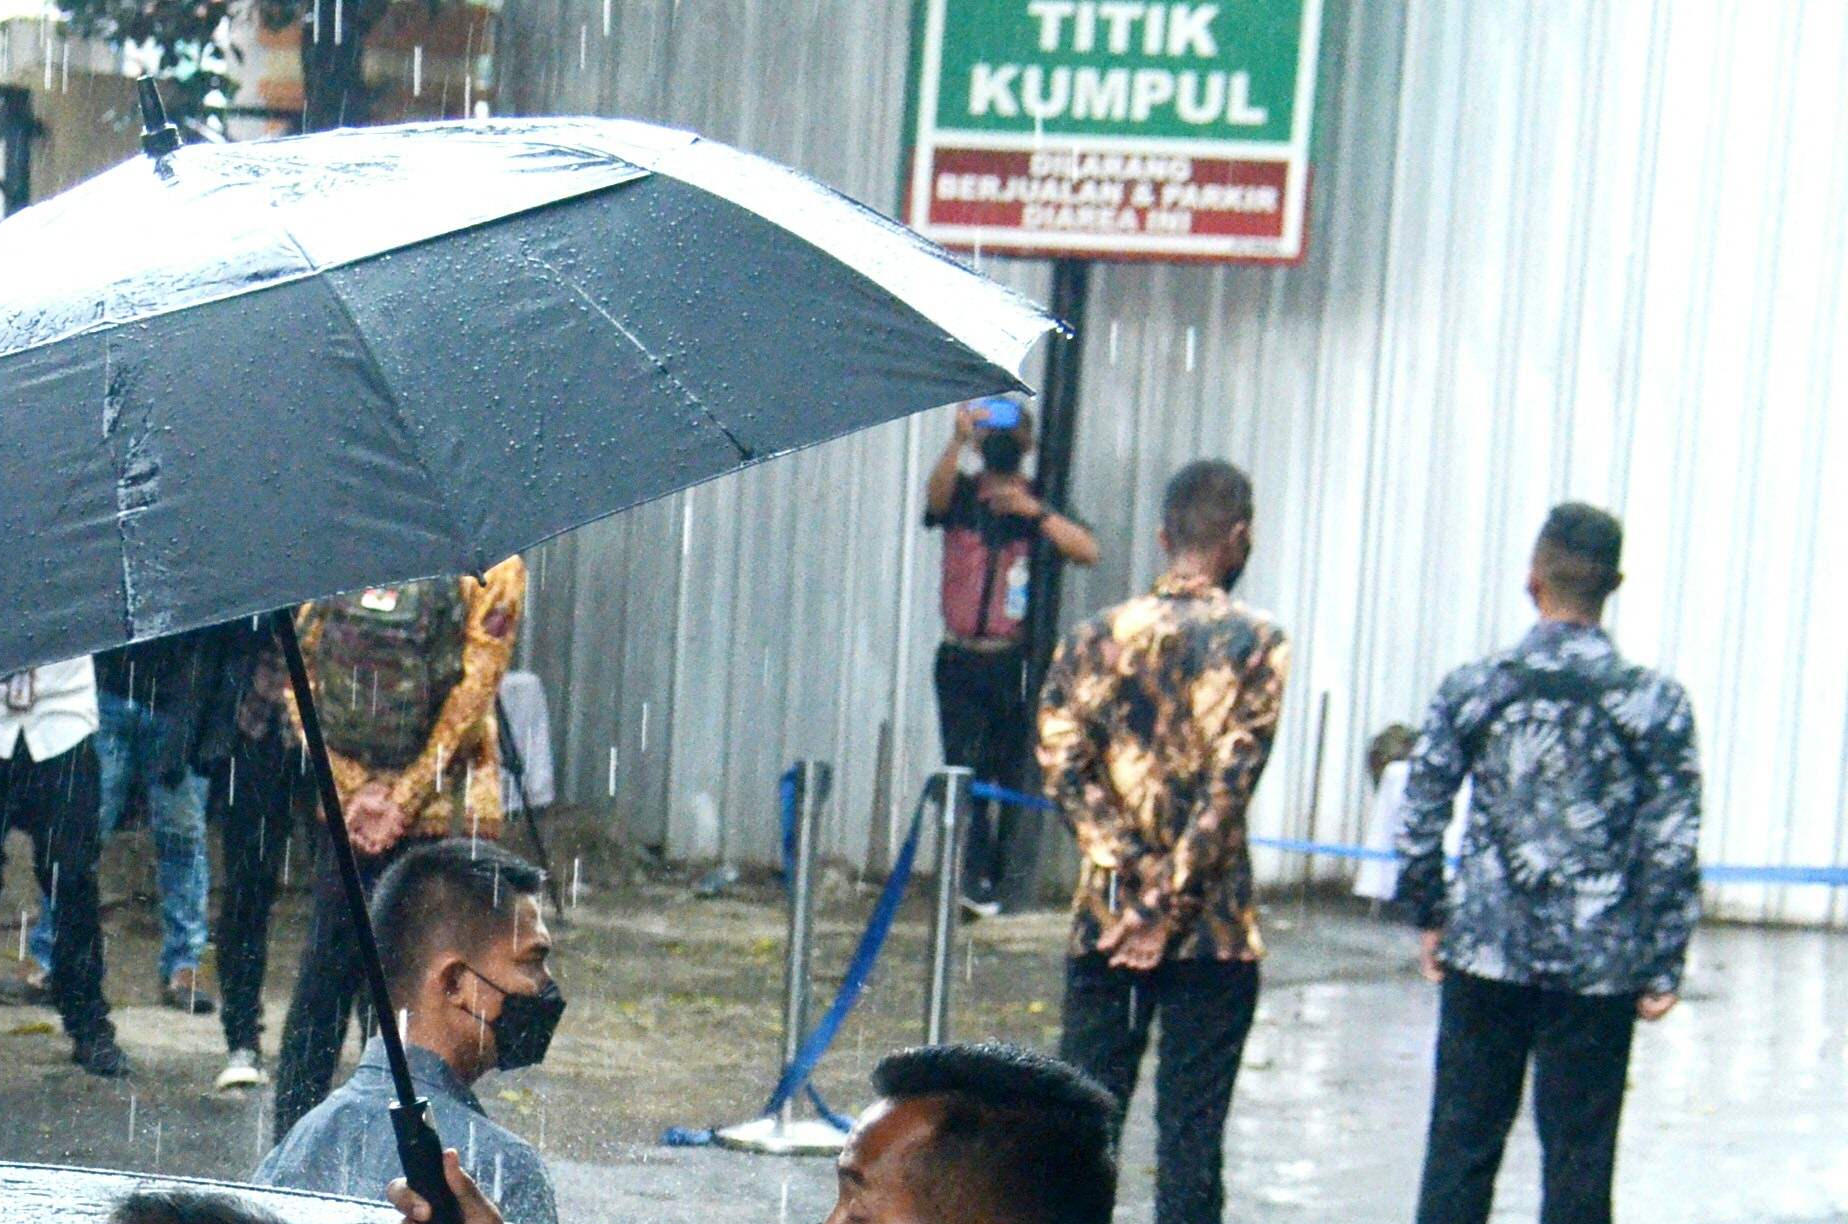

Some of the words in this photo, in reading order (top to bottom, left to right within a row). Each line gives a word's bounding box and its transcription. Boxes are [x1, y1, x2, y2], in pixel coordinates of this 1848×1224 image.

[1027, 2, 1220, 57] TITIK
[969, 64, 1268, 126] KUMPUL
[936, 173, 1124, 205] BERJUALAN
